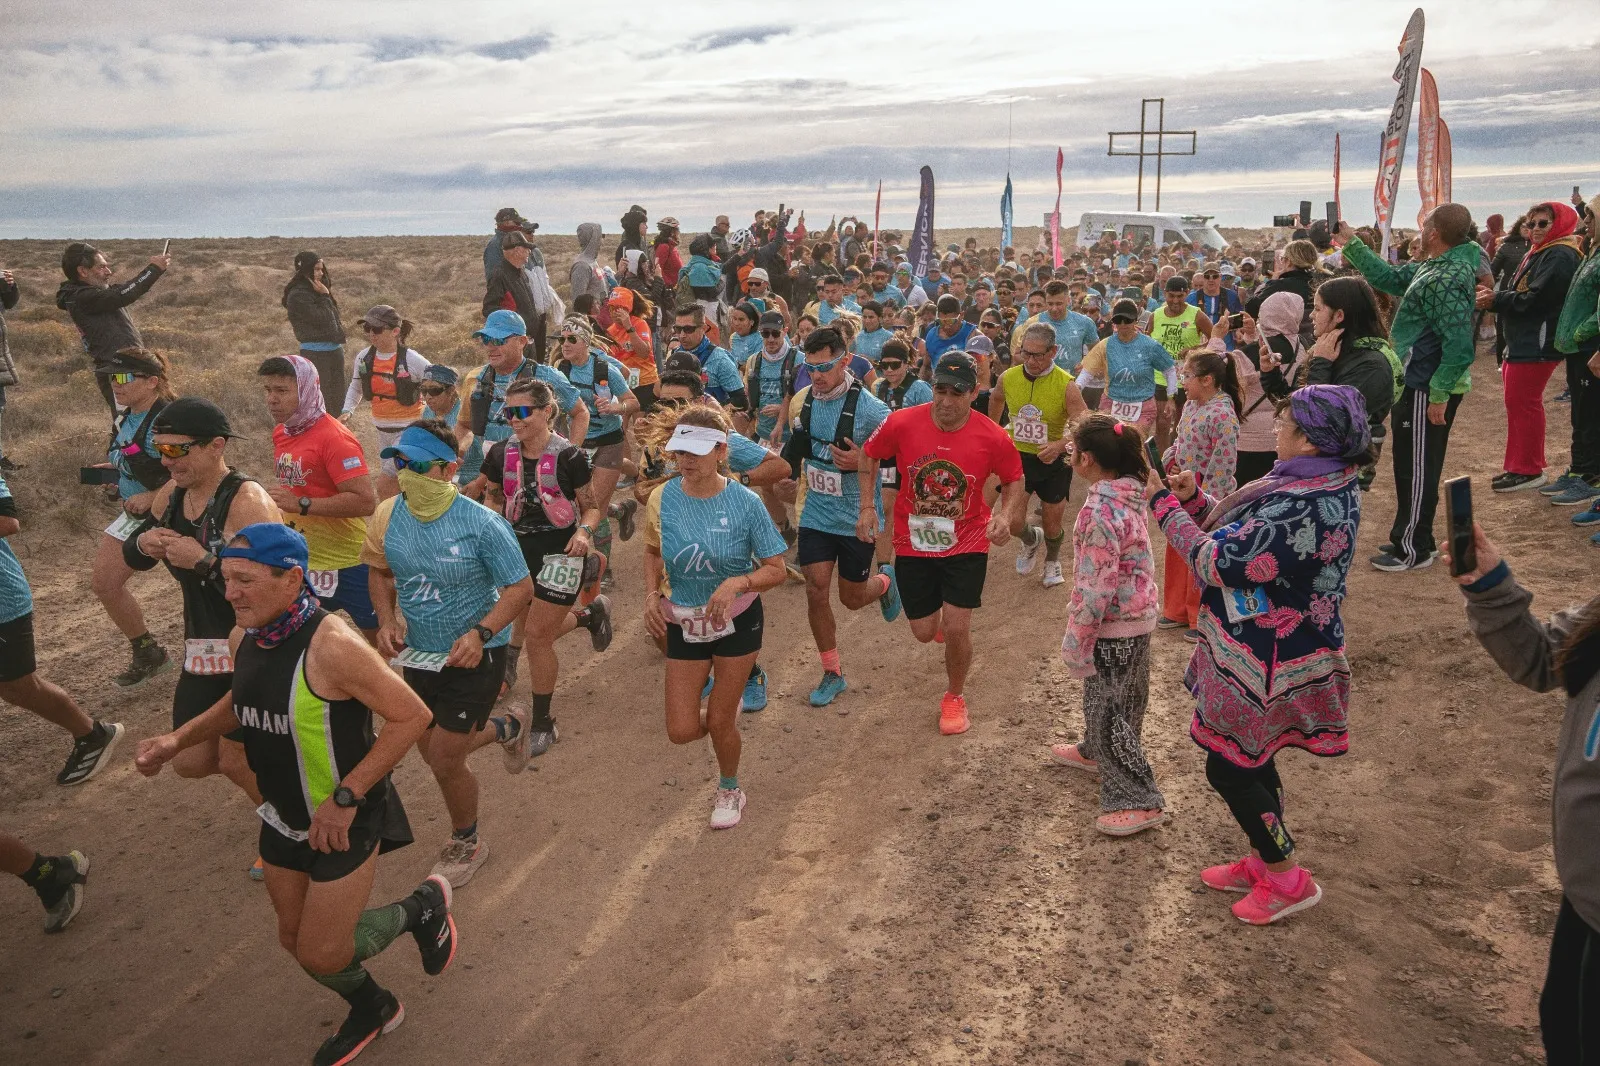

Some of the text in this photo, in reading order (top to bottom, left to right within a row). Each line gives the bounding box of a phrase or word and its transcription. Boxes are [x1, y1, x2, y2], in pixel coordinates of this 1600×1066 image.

[1113, 402, 1139, 418] 207
[1015, 422, 1044, 440] 293
[810, 471, 837, 493] 193
[914, 527, 953, 546] 106
[540, 562, 580, 588] 065
